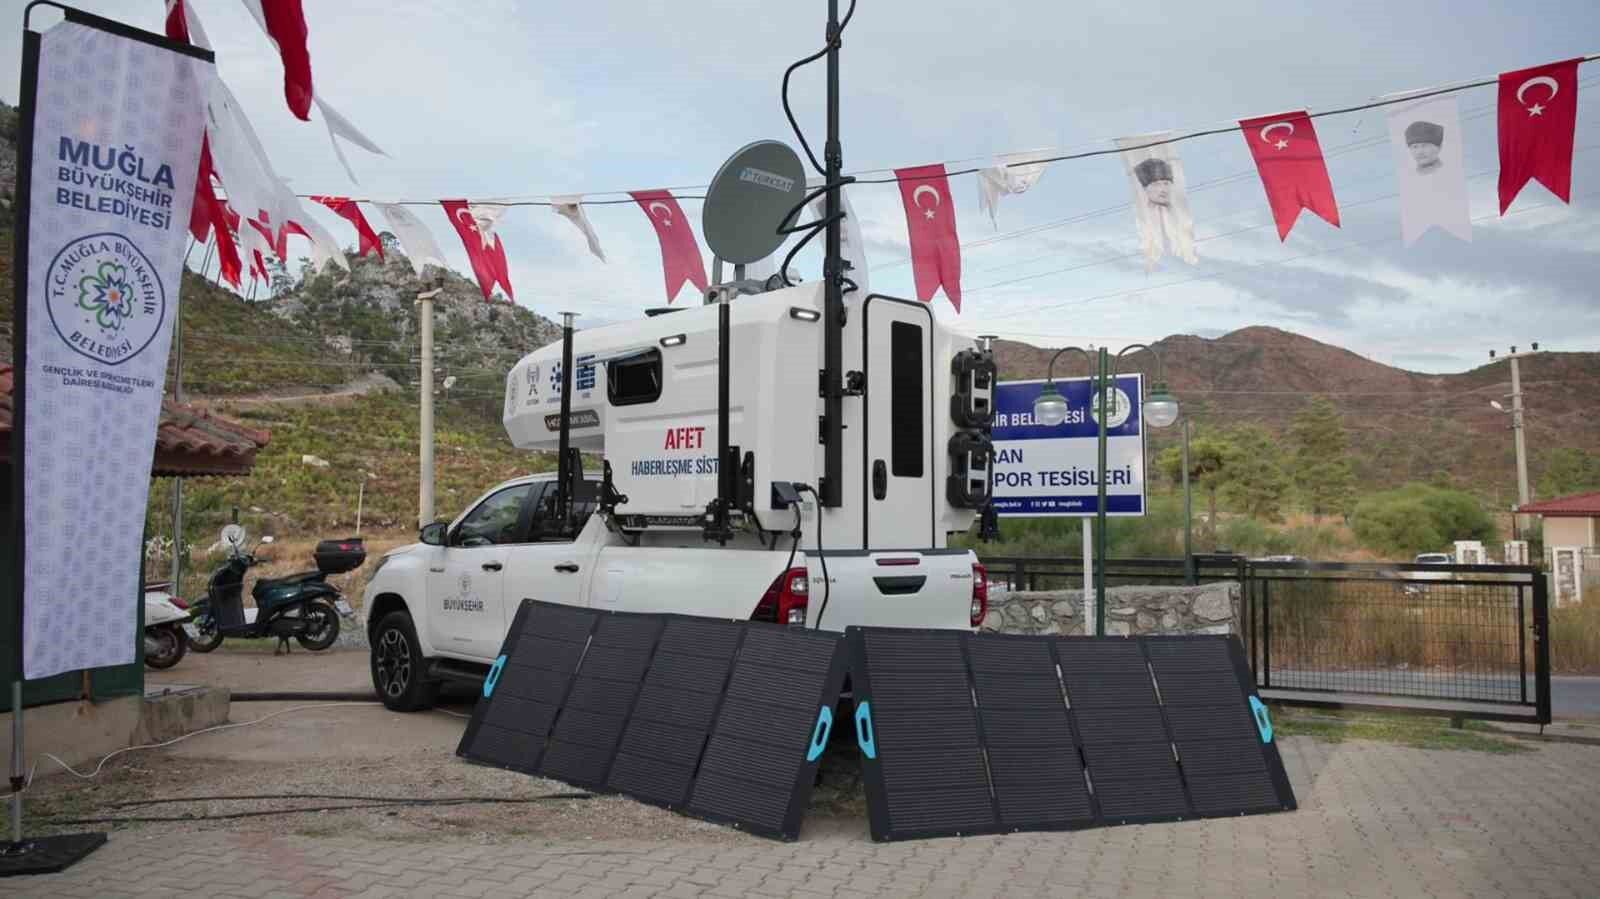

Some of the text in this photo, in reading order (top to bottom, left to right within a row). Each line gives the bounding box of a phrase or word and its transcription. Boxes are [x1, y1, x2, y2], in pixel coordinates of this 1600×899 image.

[58, 136, 175, 190] MUĞLA
[57, 166, 173, 209] BÜYÜKŞEHİR
[56, 187, 172, 230] BELEDİYESİ
[664, 426, 705, 450] AFET
[631, 455, 720, 478] HABERLEŞME SİST
[992, 472, 1032, 487] POR
